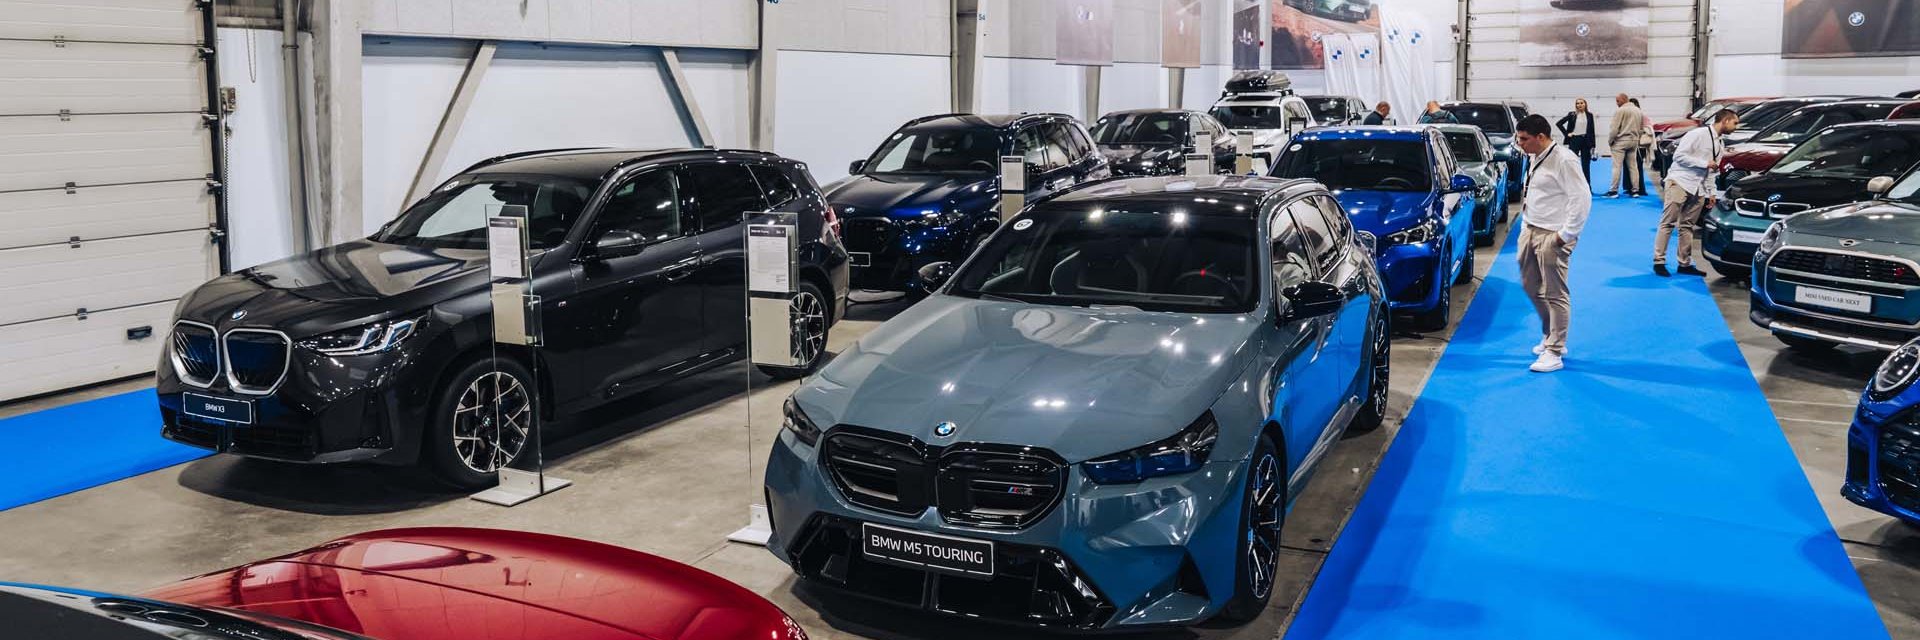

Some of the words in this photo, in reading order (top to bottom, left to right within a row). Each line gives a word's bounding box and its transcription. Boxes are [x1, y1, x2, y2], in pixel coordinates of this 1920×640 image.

[205, 403, 218, 412] BMW
[218, 405, 225, 413] X3
[871, 534, 901, 551] BMW
[904, 540, 922, 555] M5
[923, 543, 984, 564] TOURING
